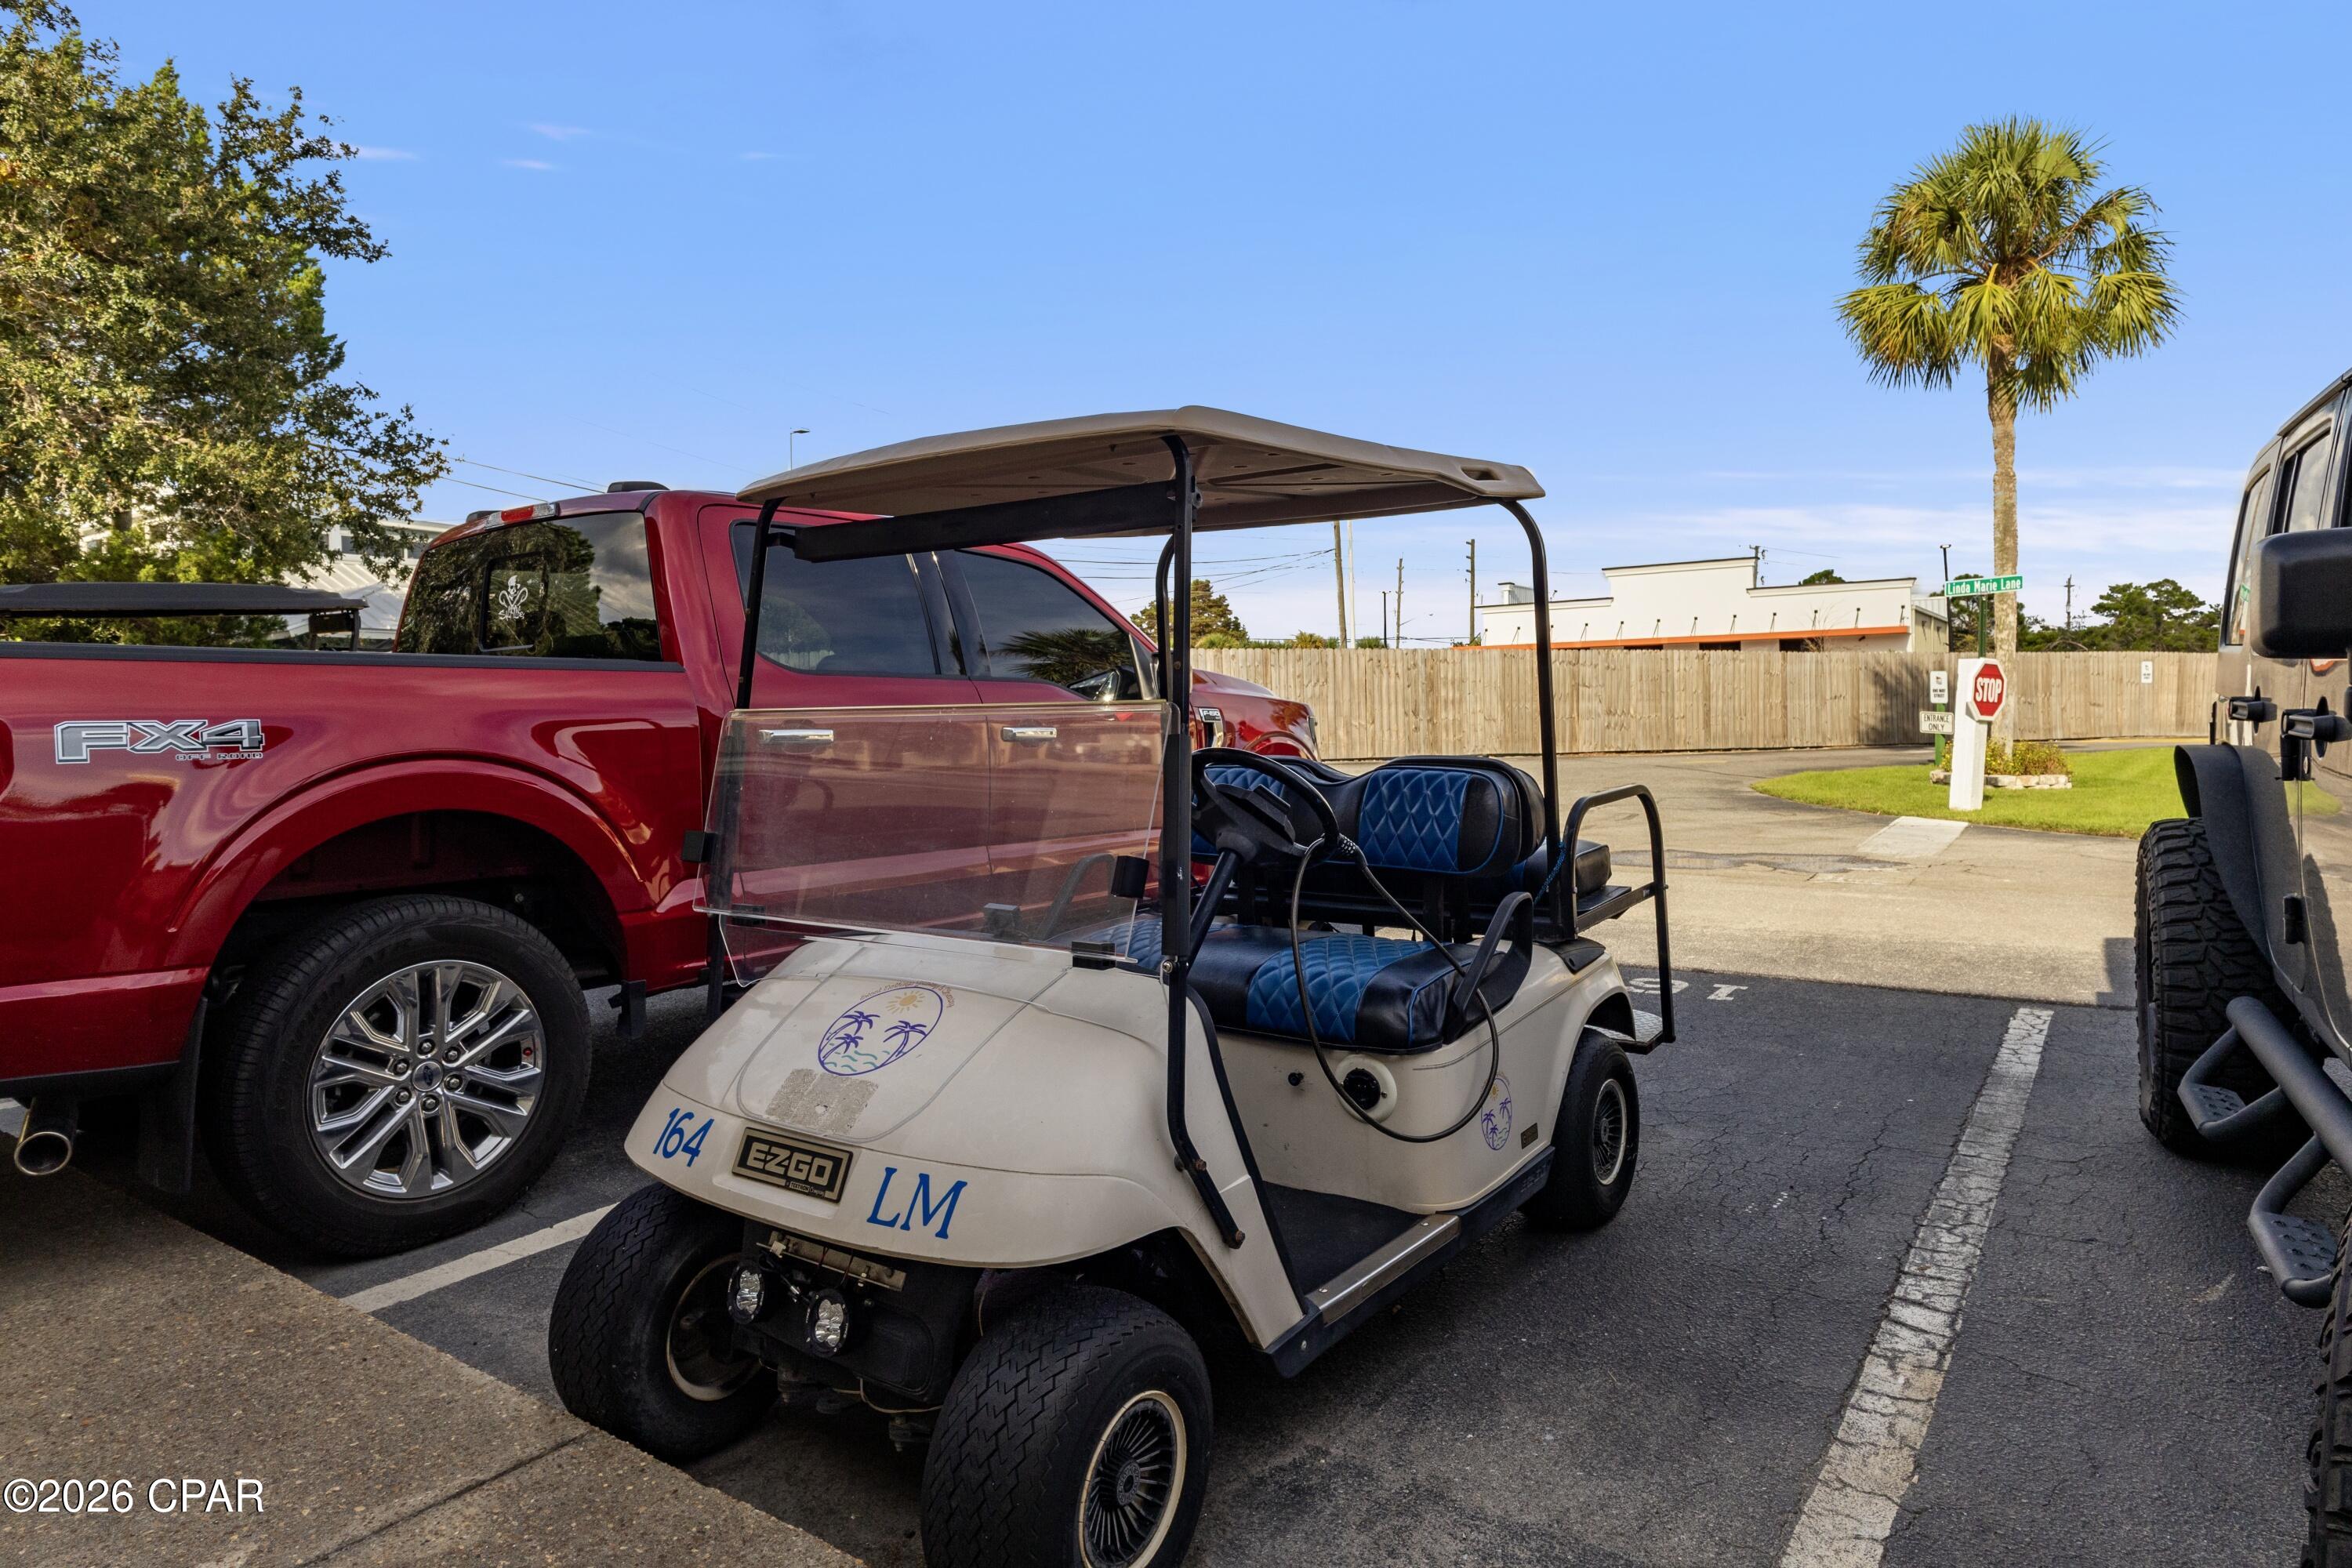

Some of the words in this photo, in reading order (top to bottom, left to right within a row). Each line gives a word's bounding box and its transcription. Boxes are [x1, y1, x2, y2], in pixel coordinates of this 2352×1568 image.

[1947, 583, 1970, 594] Linda
[1974, 580, 1998, 593] Marie
[2001, 578, 2021, 590] Lane
[1976, 677, 2002, 702] STOP
[1924, 713, 1949, 724] ENTRANCE
[1928, 723, 1945, 732] ONLY
[54, 719, 265, 764] FX4
[175, 753, 211, 761] OFF
[652, 1108, 715, 1167] 164
[790, 1181, 809, 1192] TEXTRON
[866, 1167, 968, 1240] LM
